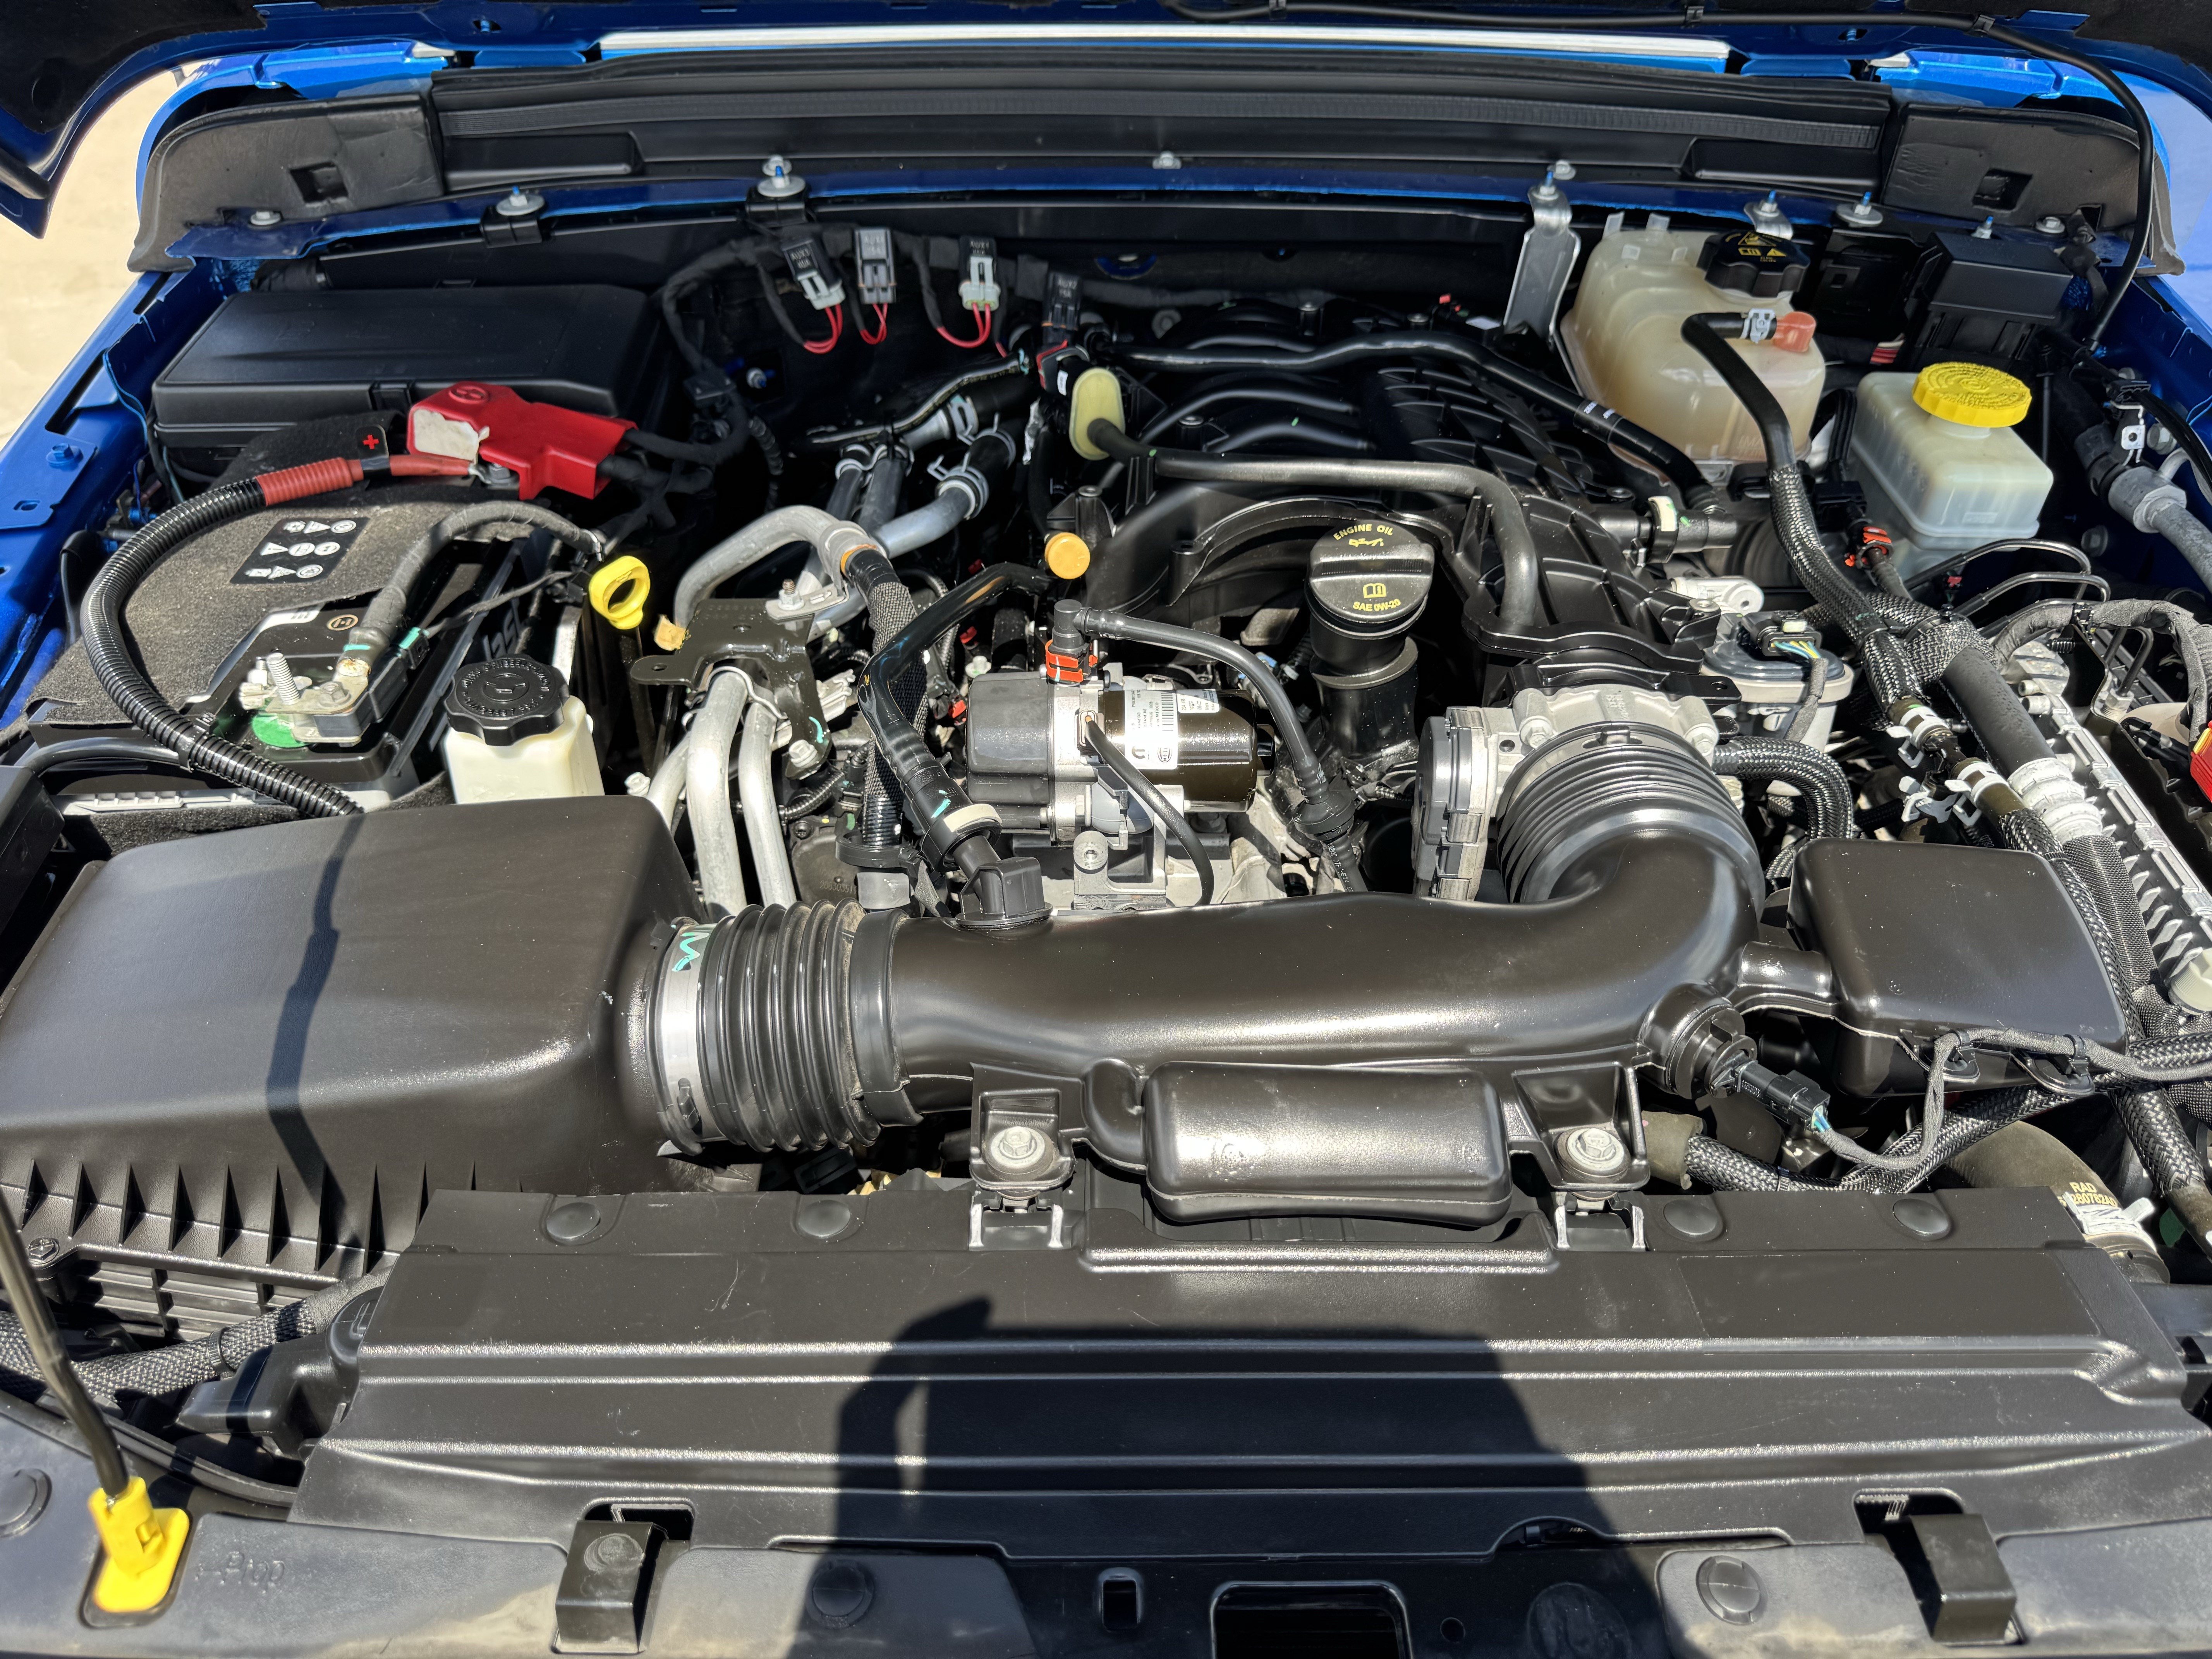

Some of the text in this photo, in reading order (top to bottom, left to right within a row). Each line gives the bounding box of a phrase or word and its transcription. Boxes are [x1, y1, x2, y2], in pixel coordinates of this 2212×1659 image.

[1333, 524, 1393, 540] ENGINE OIL
[1353, 598, 1401, 611] SAE 0W-20
[2069, 1182, 2097, 1193] RAD
[2057, 1193, 2118, 1207] 280782AD
